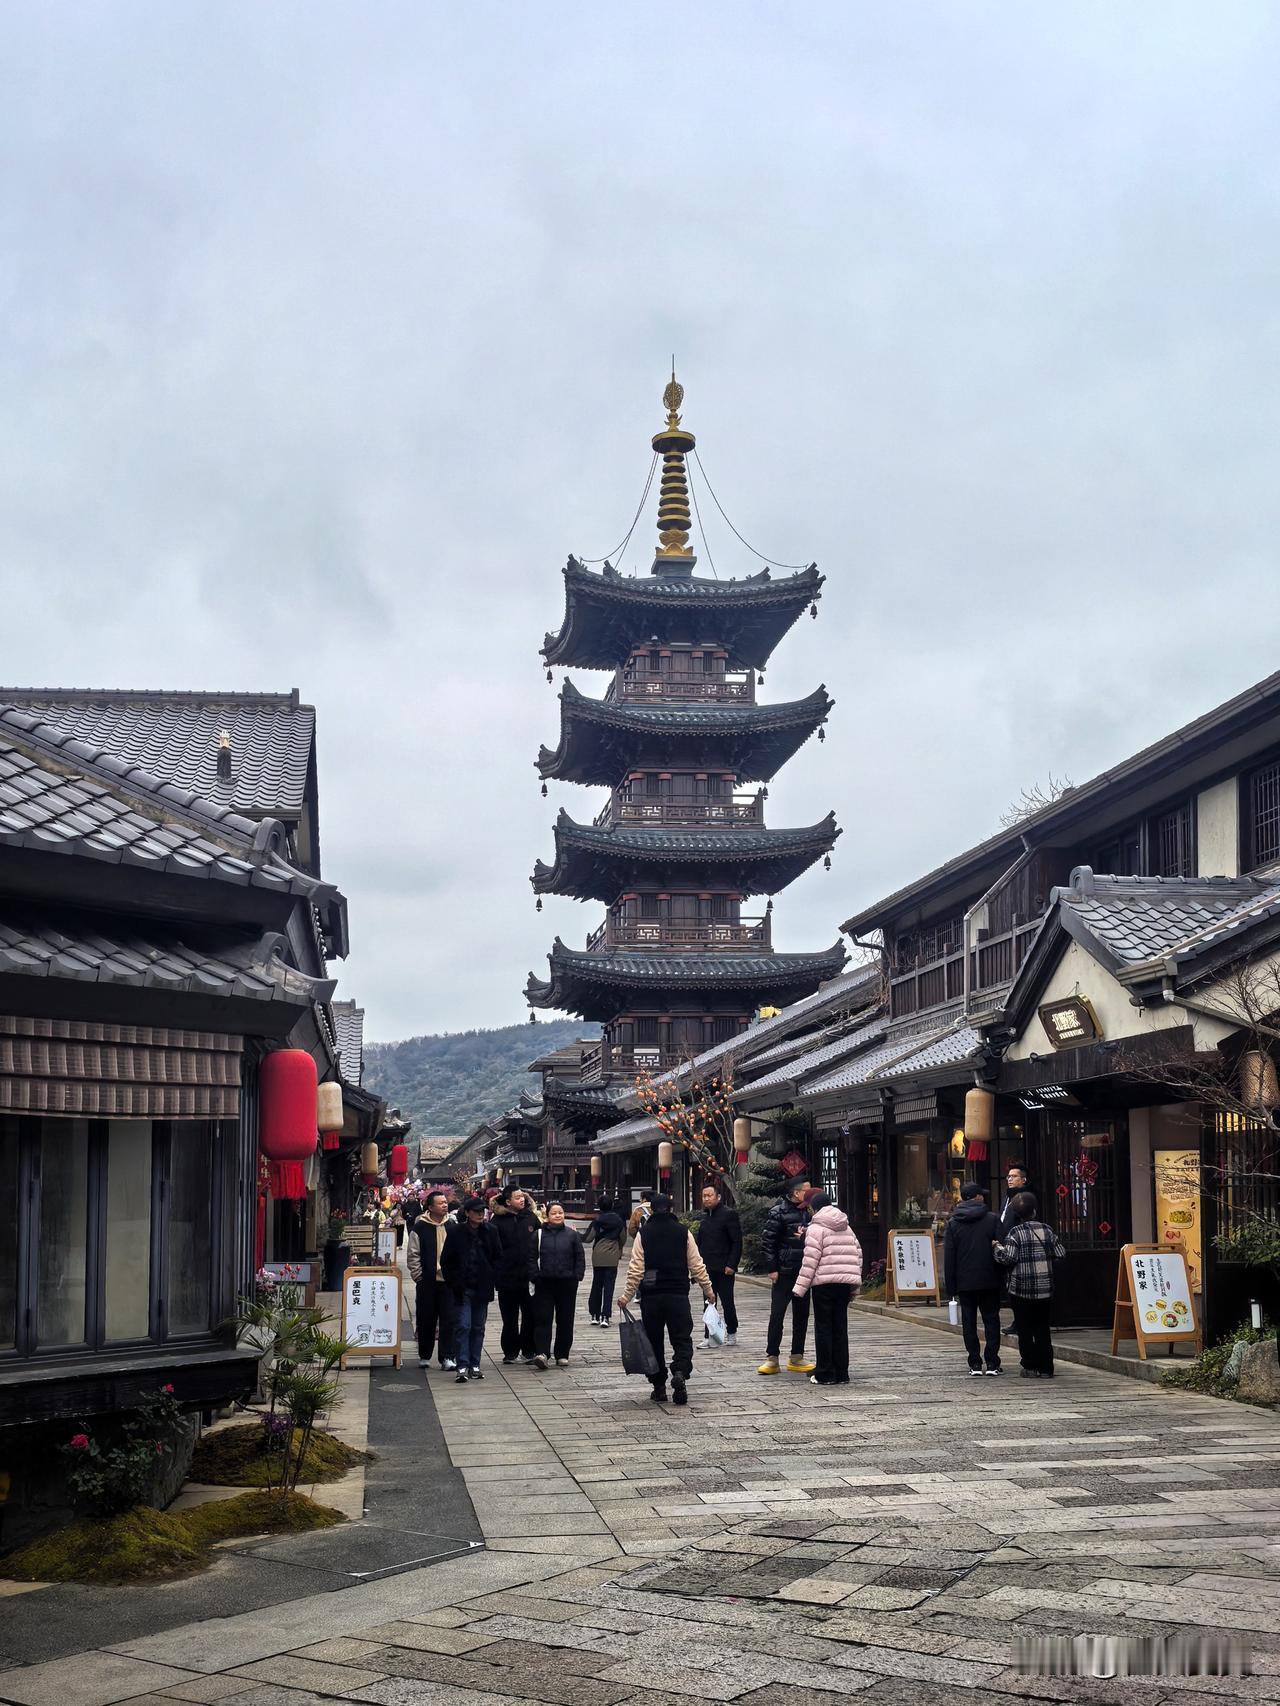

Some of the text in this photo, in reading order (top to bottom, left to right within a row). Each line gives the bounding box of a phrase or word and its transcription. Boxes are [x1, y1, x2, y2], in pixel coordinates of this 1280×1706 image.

[1135, 1259, 1148, 1290] 北野家
[352, 1280, 361, 1306] 星巴克
